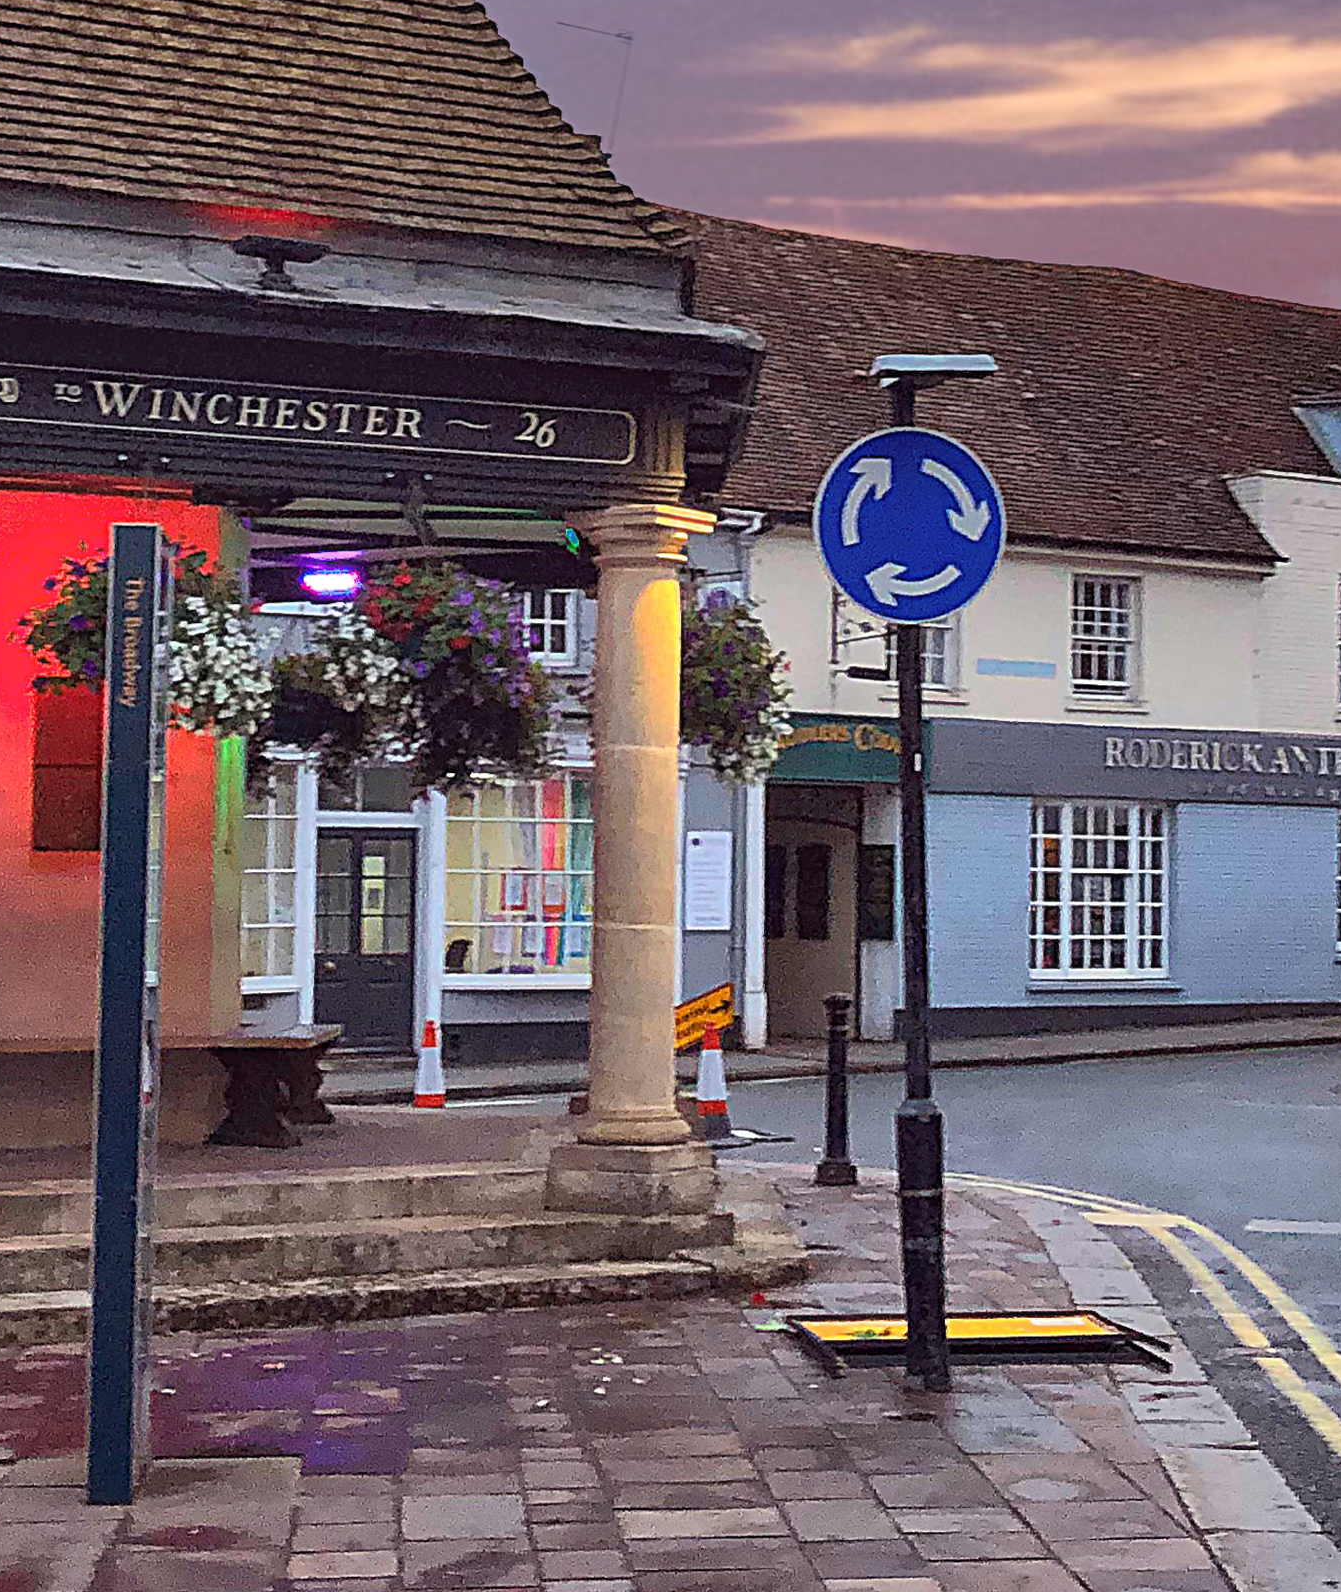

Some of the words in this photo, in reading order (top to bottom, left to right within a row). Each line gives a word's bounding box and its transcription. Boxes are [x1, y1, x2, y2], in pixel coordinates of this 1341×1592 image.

[89, 380, 422, 438] WINCHESTER
[514, 411, 558, 448] 26
[123, 577, 145, 611] The
[117, 616, 143, 707] Broadway
[1106, 736, 1263, 773] RODERICK
